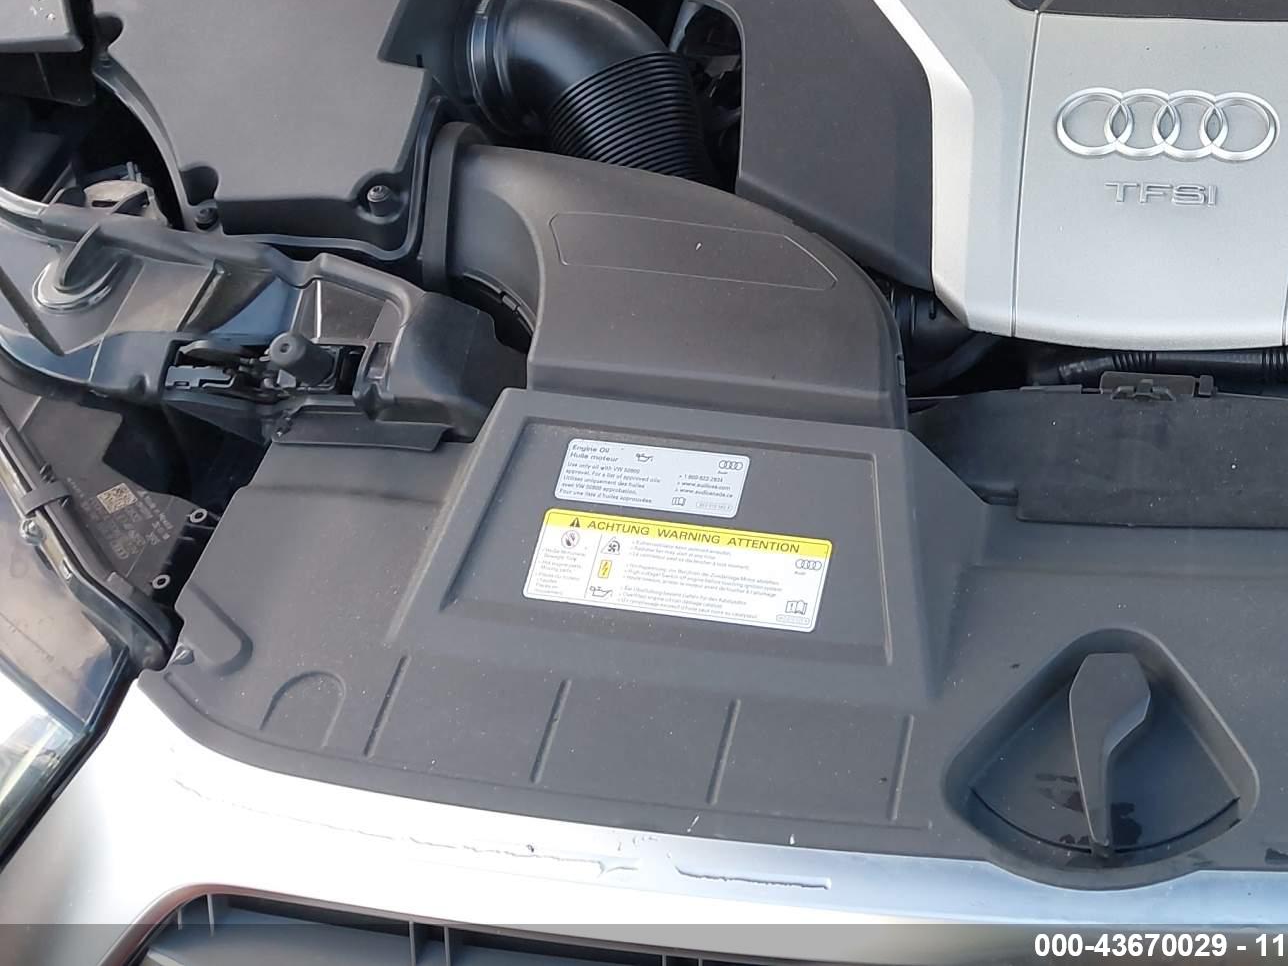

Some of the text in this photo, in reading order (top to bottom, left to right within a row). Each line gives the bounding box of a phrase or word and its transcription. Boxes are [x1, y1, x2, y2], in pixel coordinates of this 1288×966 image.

[1104, 182, 1220, 208] TFSI
[572, 444, 598, 454] Engine
[590, 455, 619, 463] moteur
[588, 520, 650, 536] ACHTUNG
[657, 528, 721, 545] WARNING
[727, 537, 800, 554] ATTENTION
